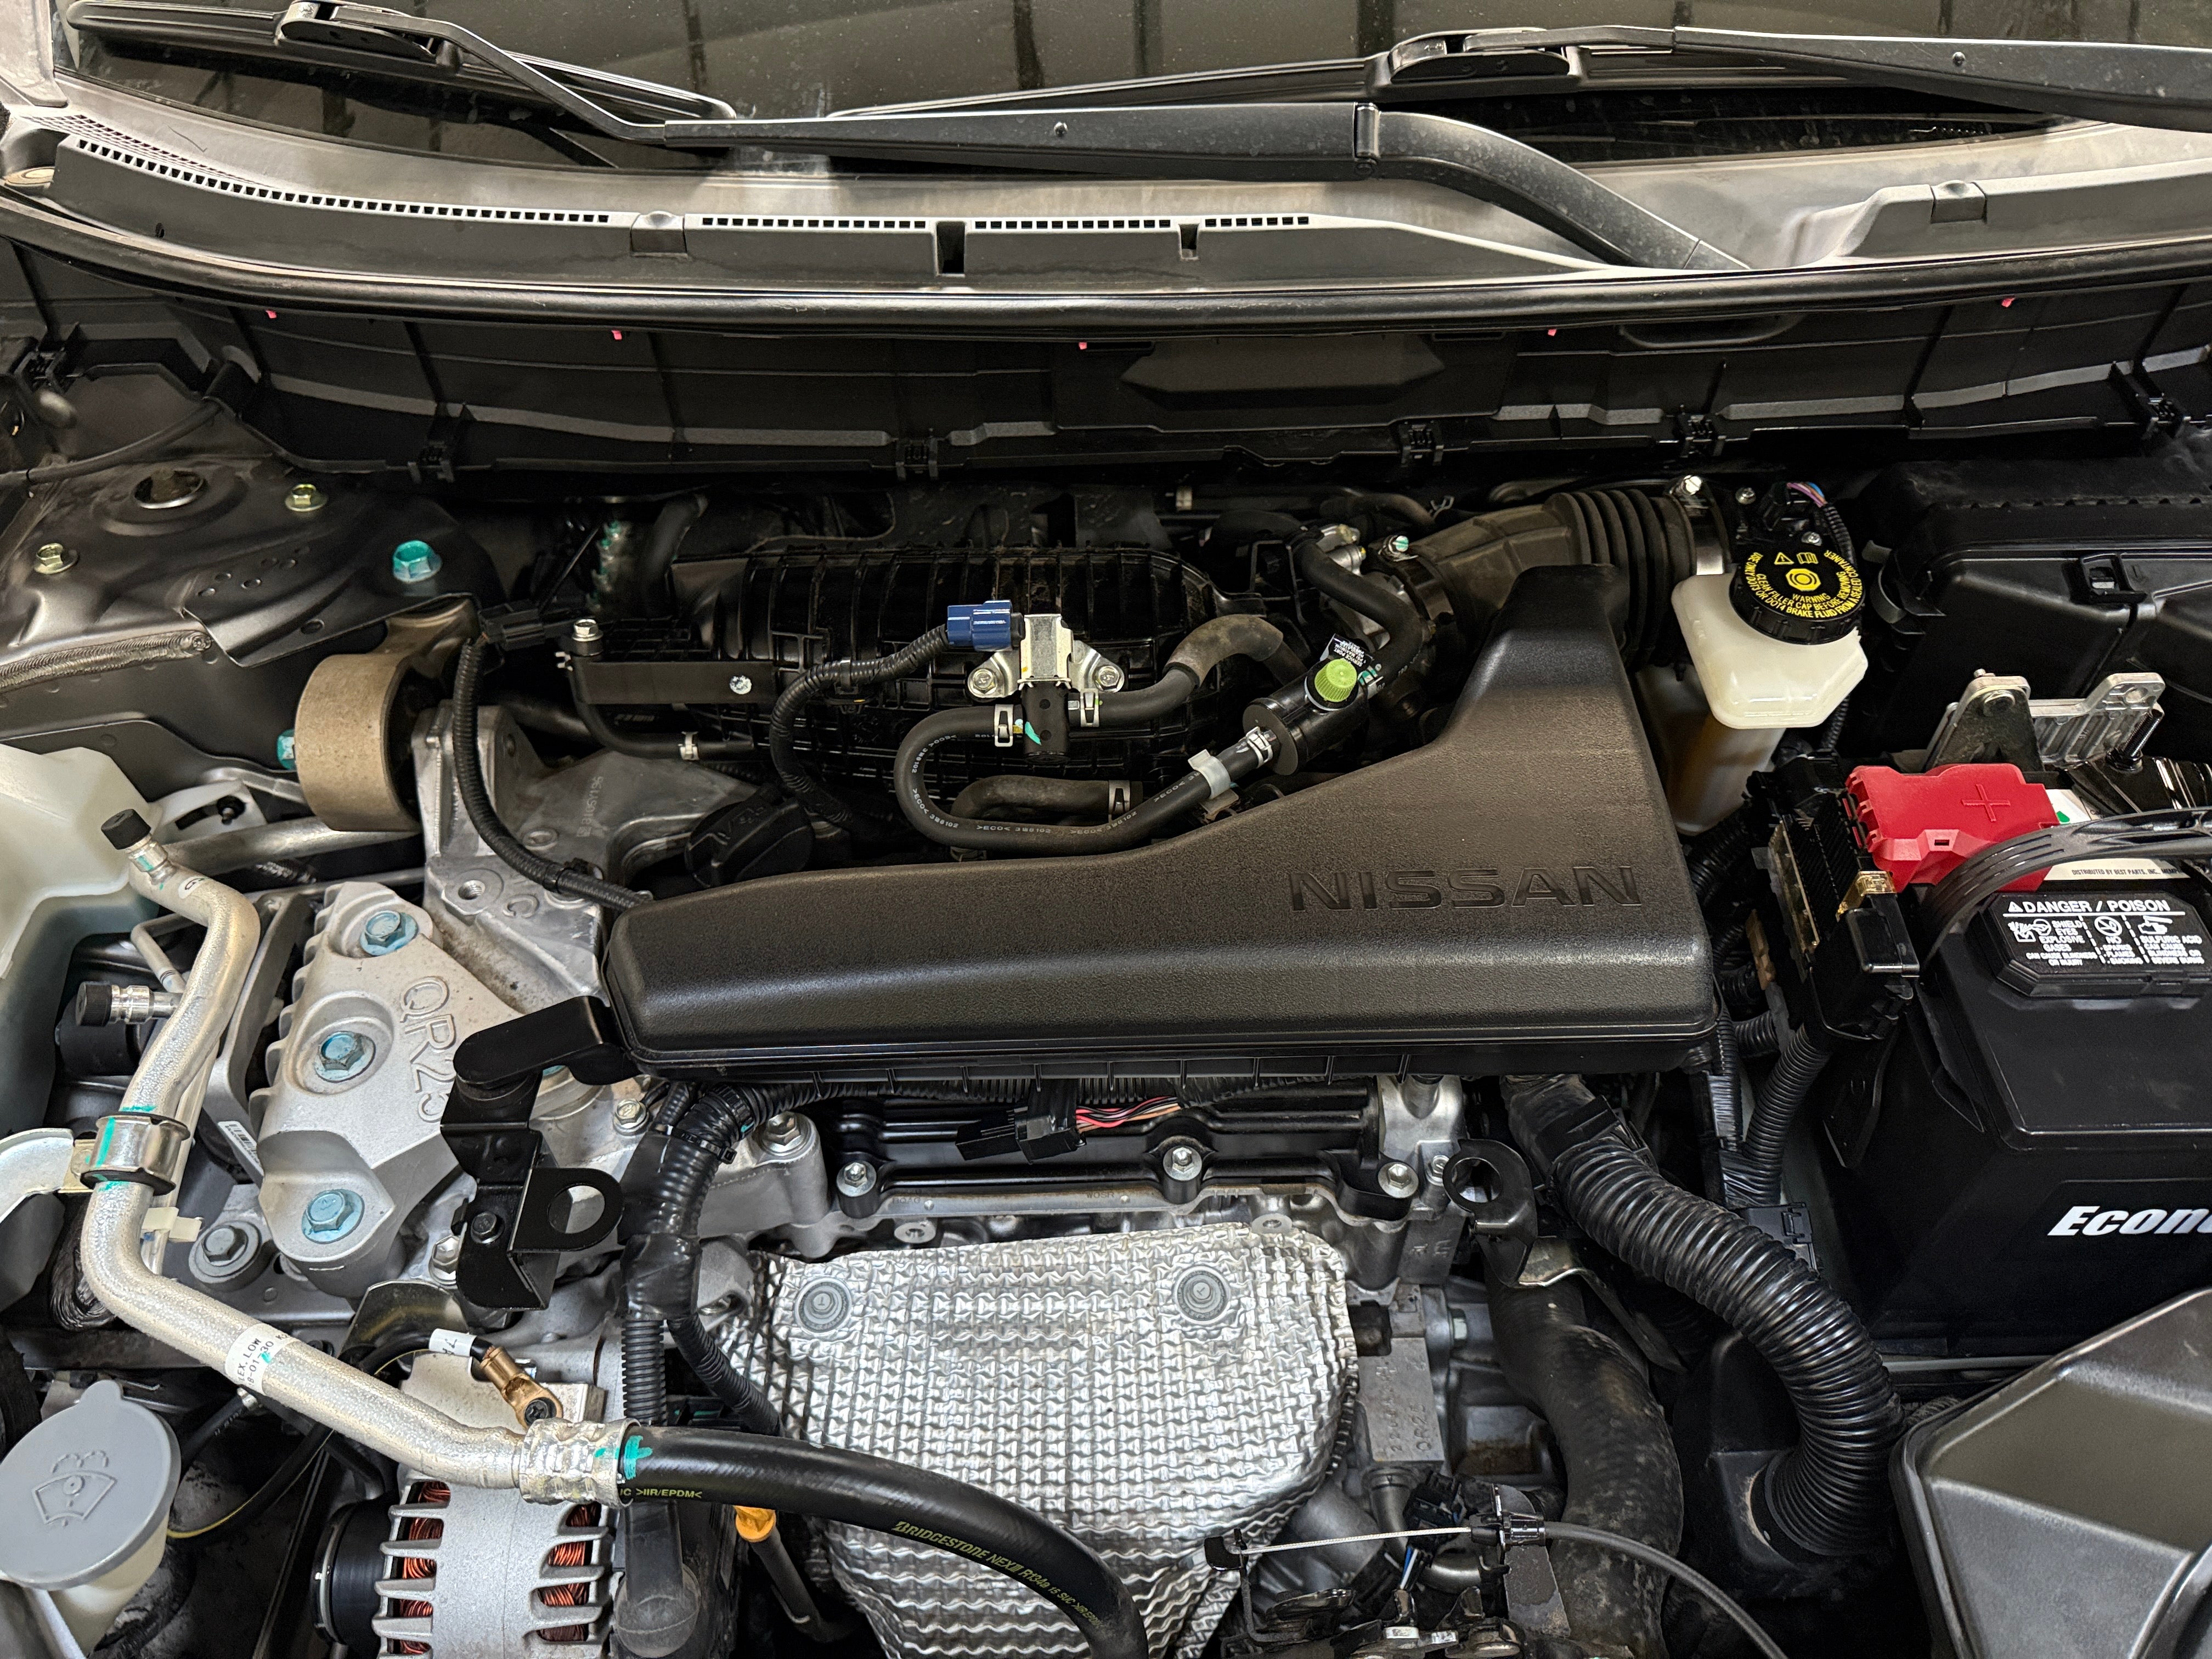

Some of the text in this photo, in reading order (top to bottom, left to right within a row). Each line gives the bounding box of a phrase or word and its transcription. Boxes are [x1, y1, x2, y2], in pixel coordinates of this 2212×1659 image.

[1747, 552, 1763, 563] USE
[1824, 550, 1859, 577] CONTAINER
[1745, 562, 1756, 577] ONLY
[1746, 576, 1759, 591] DOT3
[1850, 578, 1863, 599] SEALED
[1756, 573, 1773, 591] CLEAN
[1768, 589, 1794, 607] FILLER
[1814, 597, 1843, 611] BEFORE
[1836, 572, 1850, 600] REMOVING
[1756, 590, 1768, 600] OR
[1792, 592, 1831, 603] WARNING
[1765, 597, 1785, 611] DOT4
[1835, 600, 1856, 614] FROM
[1786, 606, 1814, 618] BRAKE
[1814, 608, 1838, 618] FLUID
[1344, 653, 1363, 668] SERVICE
[1288, 866, 1642, 911] NISSAN
[2022, 900, 2170, 913] DANGER / POISON
[2052, 920, 2083, 928] SHIELD
[2055, 928, 2078, 936] EYES
[2039, 935, 2085, 944] EXPLOSIVE
[2106, 936, 2122, 944] NO
[2140, 935, 2202, 944] SULFURIC ACID
[2043, 944, 2072, 952] GASES
[400, 976, 456, 1123] QR25
[243, 1338, 262, 1358] LOW
[635, 1488, 703, 1499] >IIR/EPDM<
[891, 1521, 990, 1559] BRIDGESTONE
[1018, 1568, 1051, 1588] R134a
